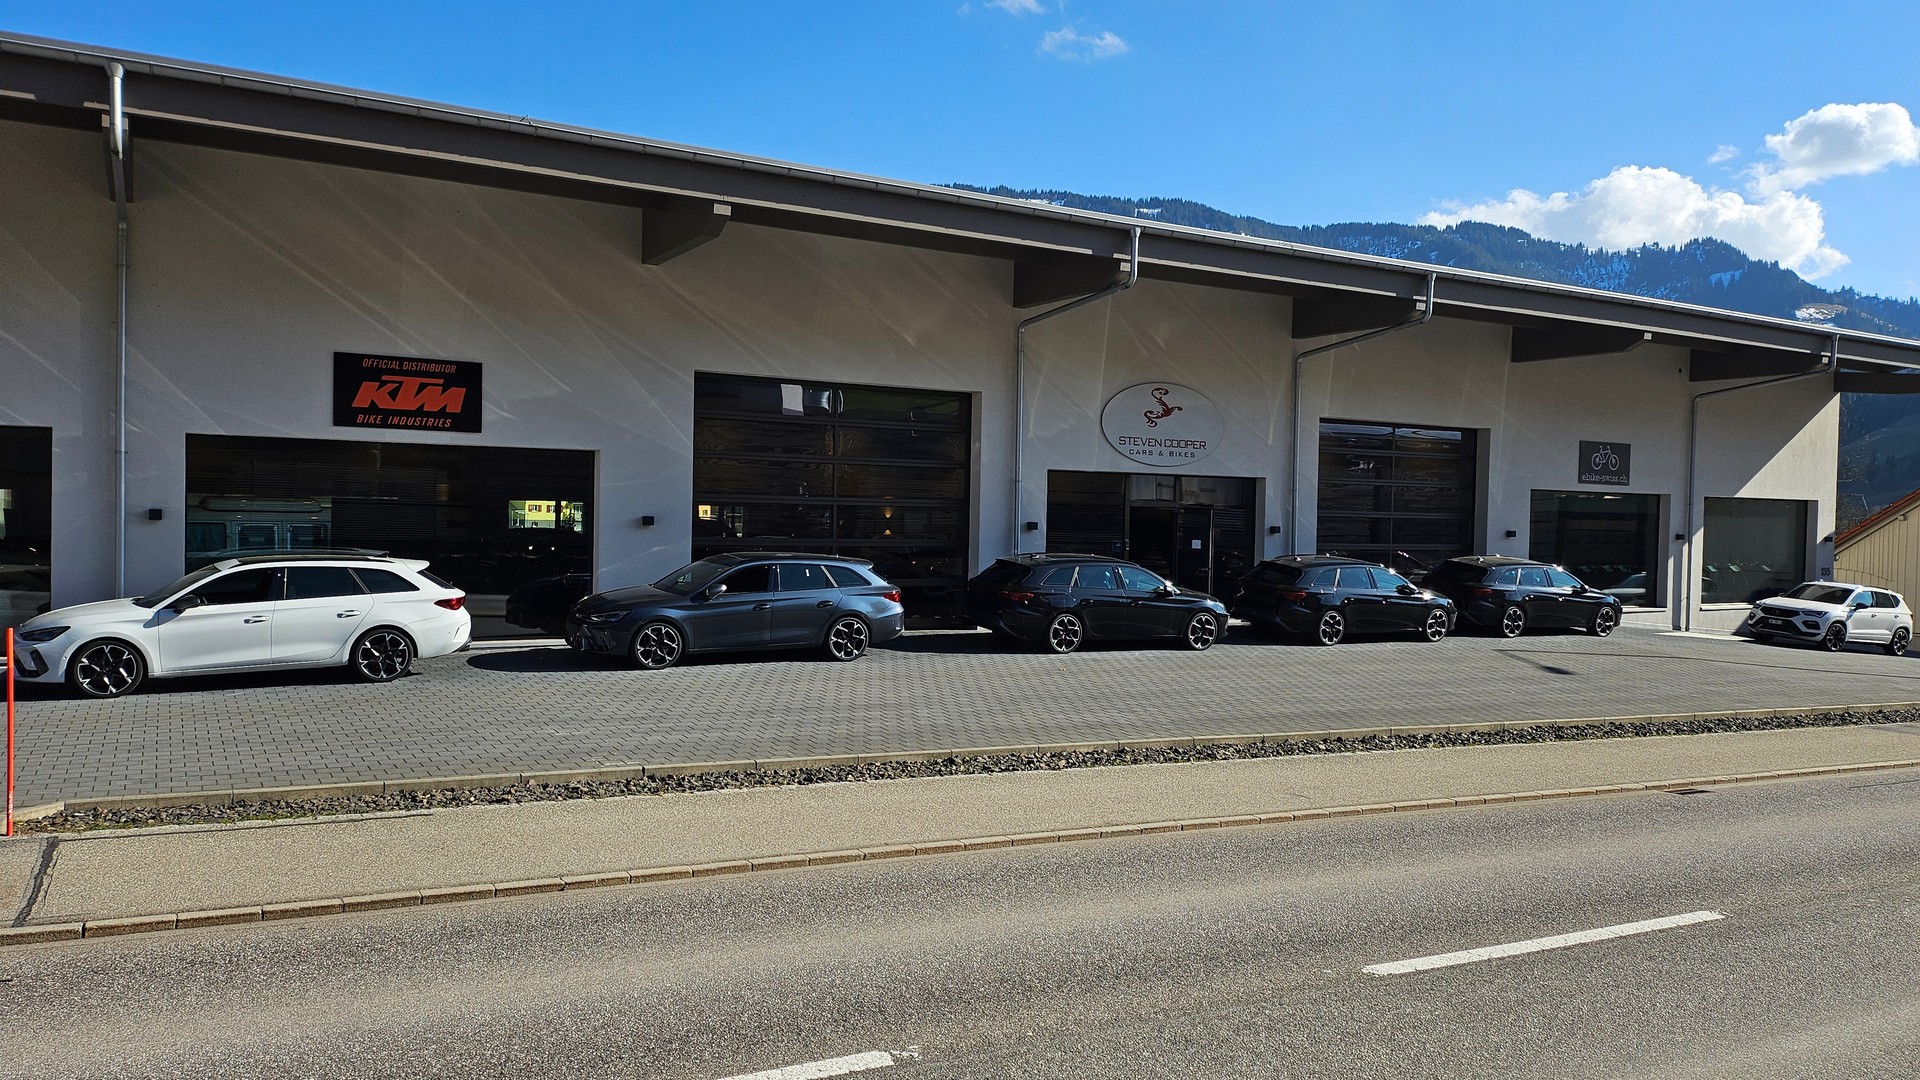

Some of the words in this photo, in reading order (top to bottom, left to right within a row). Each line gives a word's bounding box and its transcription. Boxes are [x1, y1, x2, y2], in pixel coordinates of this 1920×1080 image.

[362, 358, 400, 370] OFFICIAL
[402, 362, 457, 373] DISTRIBUTOR
[352, 375, 466, 413] KTM
[356, 414, 383, 424] BIKE
[387, 416, 452, 428] INDUSTRIES
[1118, 436, 1162, 447] STEVEN
[1164, 439, 1207, 450] COOPER
[1128, 448, 1154, 456] CARS
[1169, 450, 1196, 459] BIKES
[1820, 567, 1831, 576] 135
